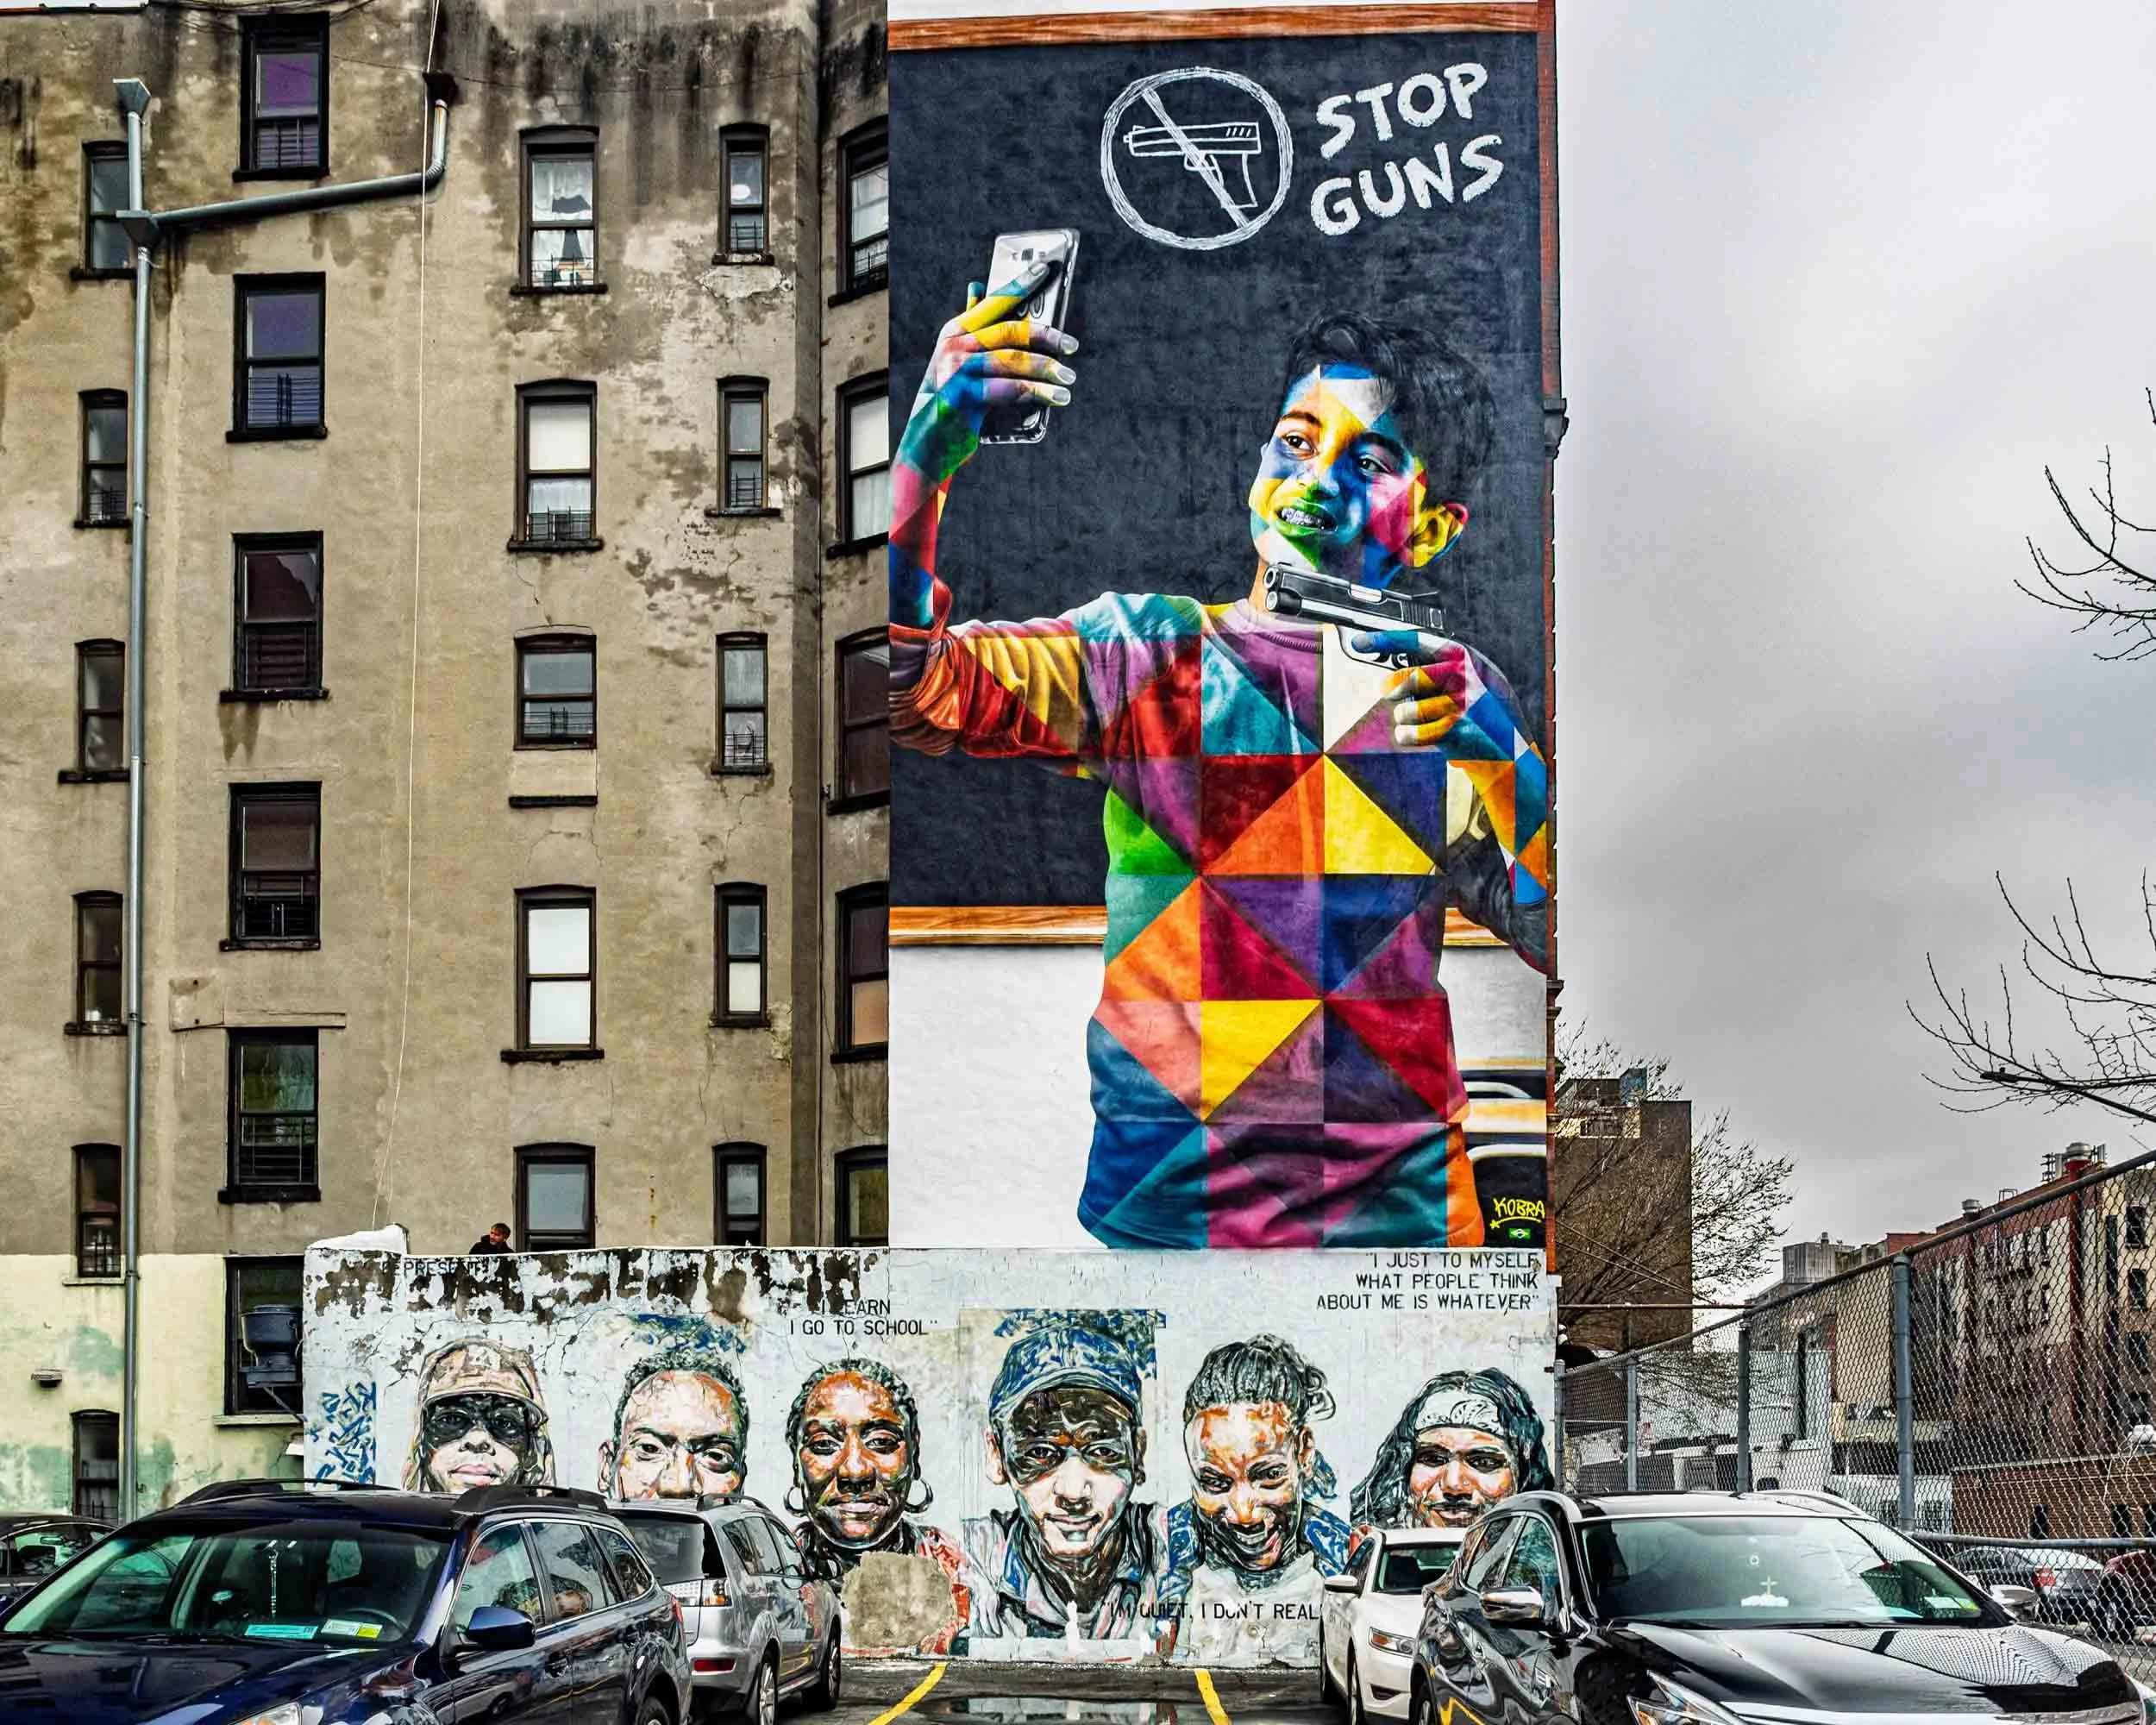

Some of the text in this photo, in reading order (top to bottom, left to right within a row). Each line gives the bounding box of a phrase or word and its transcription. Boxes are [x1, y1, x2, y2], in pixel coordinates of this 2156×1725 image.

[1316, 62, 1489, 160] STOP
[1310, 135, 1504, 236] GUNS
[1493, 1197, 1545, 1219] KOBRA
[1387, 1252, 1430, 1268] JUST
[1439, 1252, 1462, 1268] TO
[1356, 1273, 1539, 1289] WHAT PEOPLE THINK
[835, 1299, 891, 1315] EARN
[1317, 1294, 1372, 1309] ABOUT
[1382, 1294, 1405, 1309] ME
[1414, 1294, 1428, 1309] IS
[802, 1320, 824, 1335] GO
[833, 1320, 856, 1335] TO
